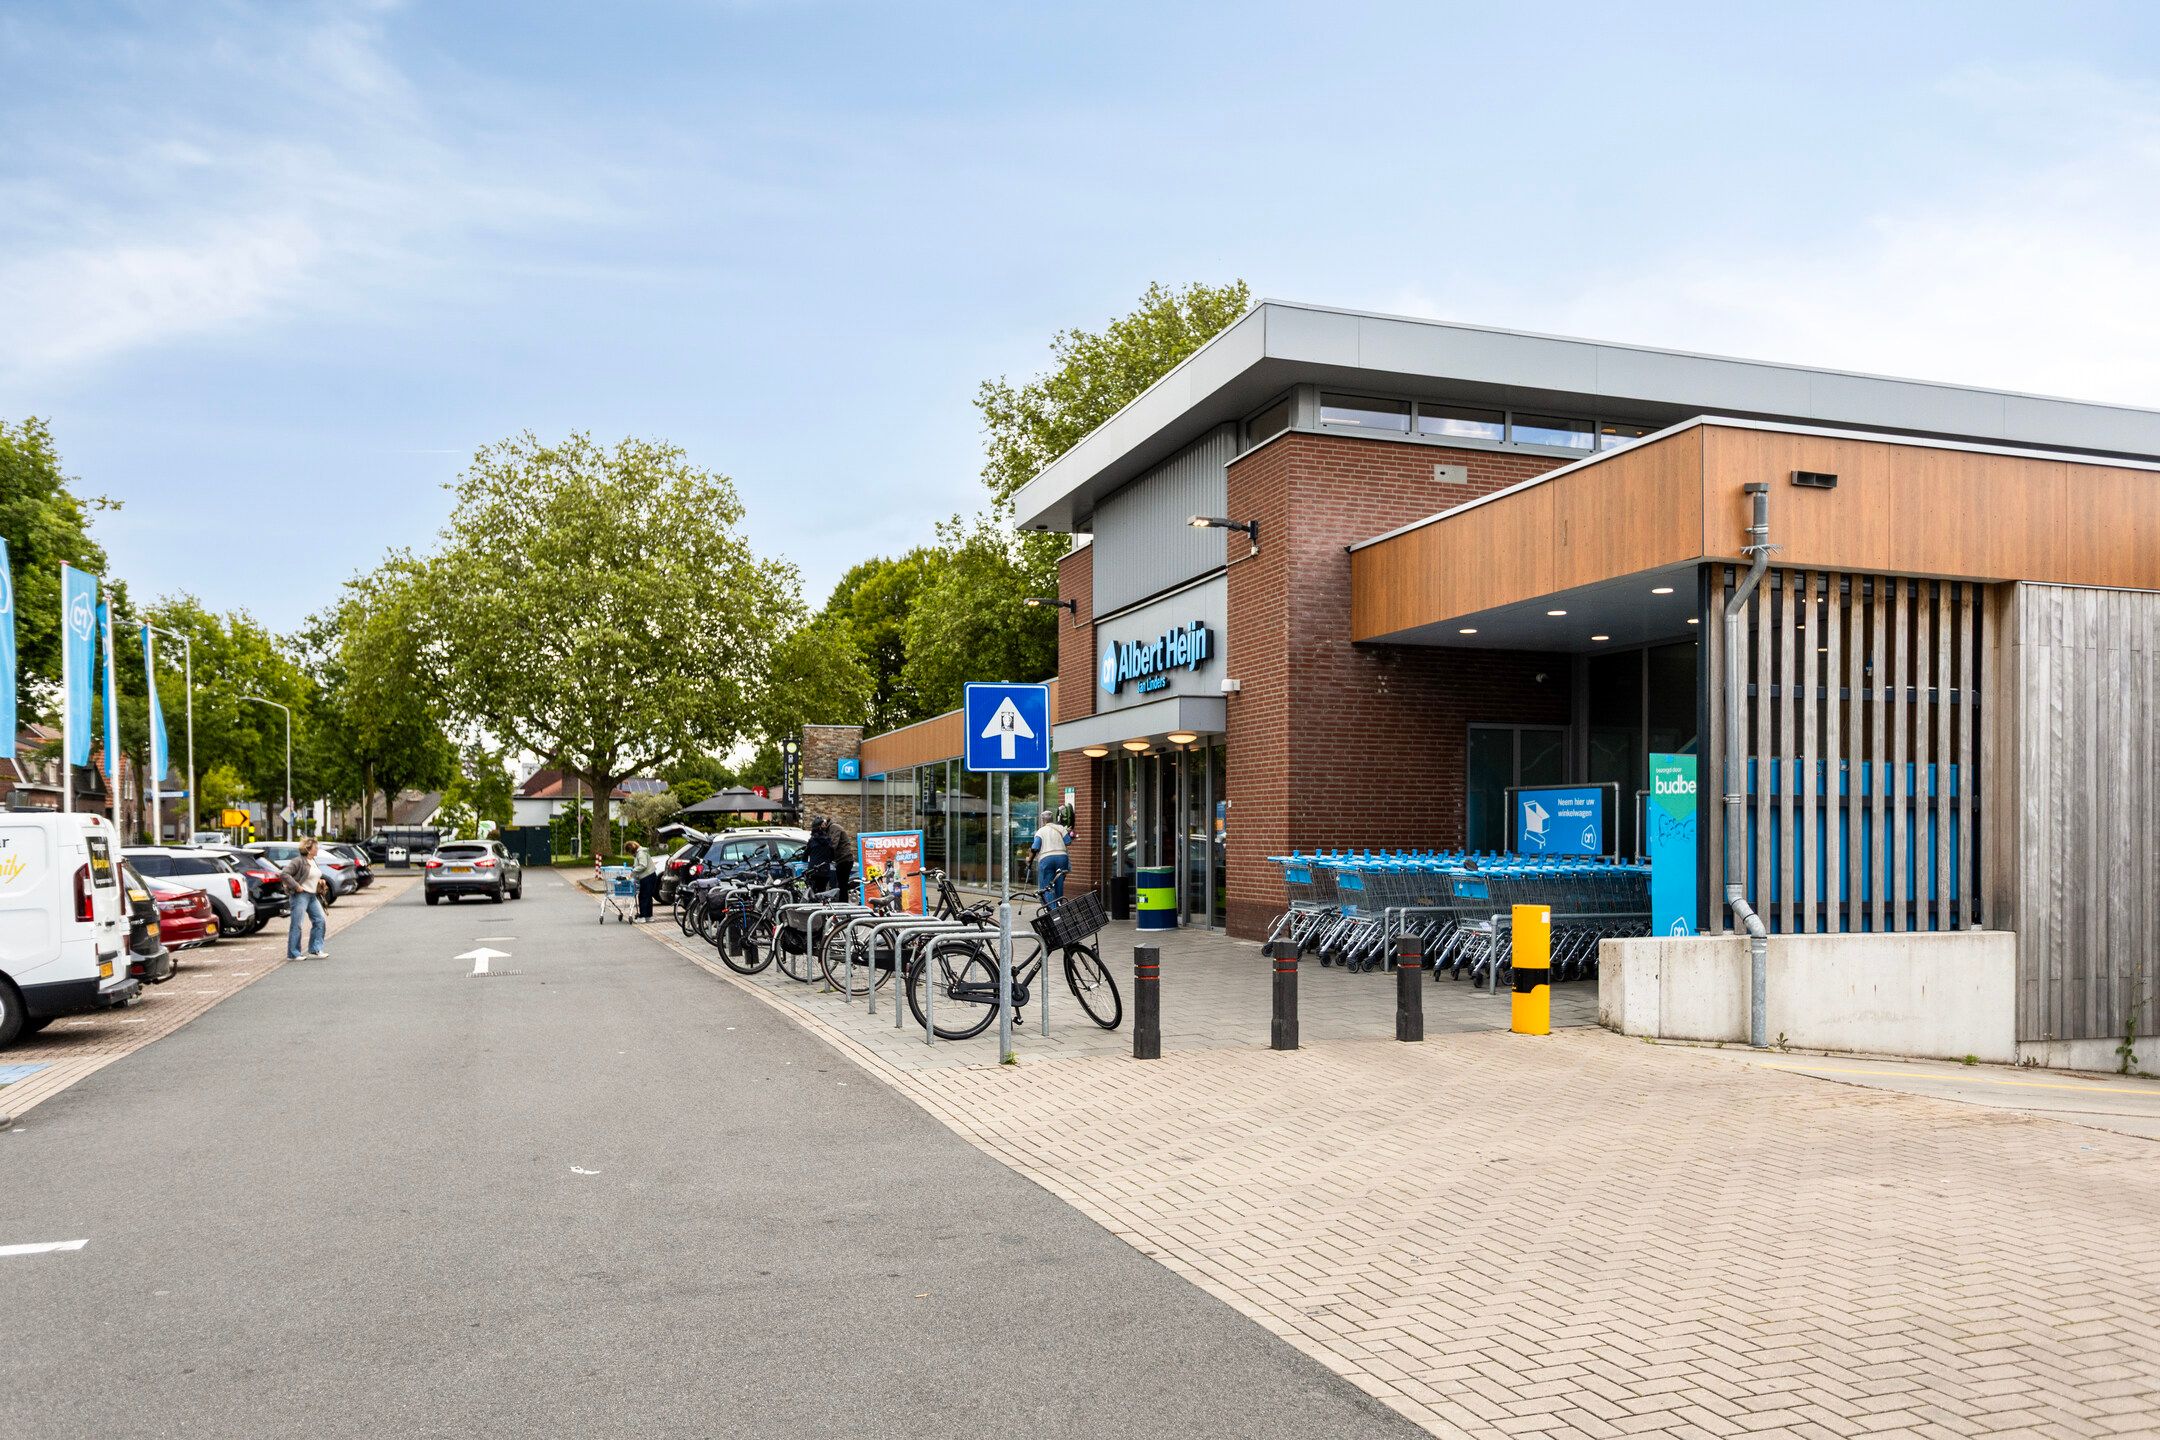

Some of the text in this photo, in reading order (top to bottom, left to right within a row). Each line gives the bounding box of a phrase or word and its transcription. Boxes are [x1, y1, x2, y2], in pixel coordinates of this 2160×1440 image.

[1118, 620, 1207, 682] Albert Heijn
[1655, 774, 1697, 794] budbe
[1557, 797, 1595, 806] Neem hier uw
[1557, 809, 1593, 819] winkelwagen
[875, 837, 917, 849] BONUS
